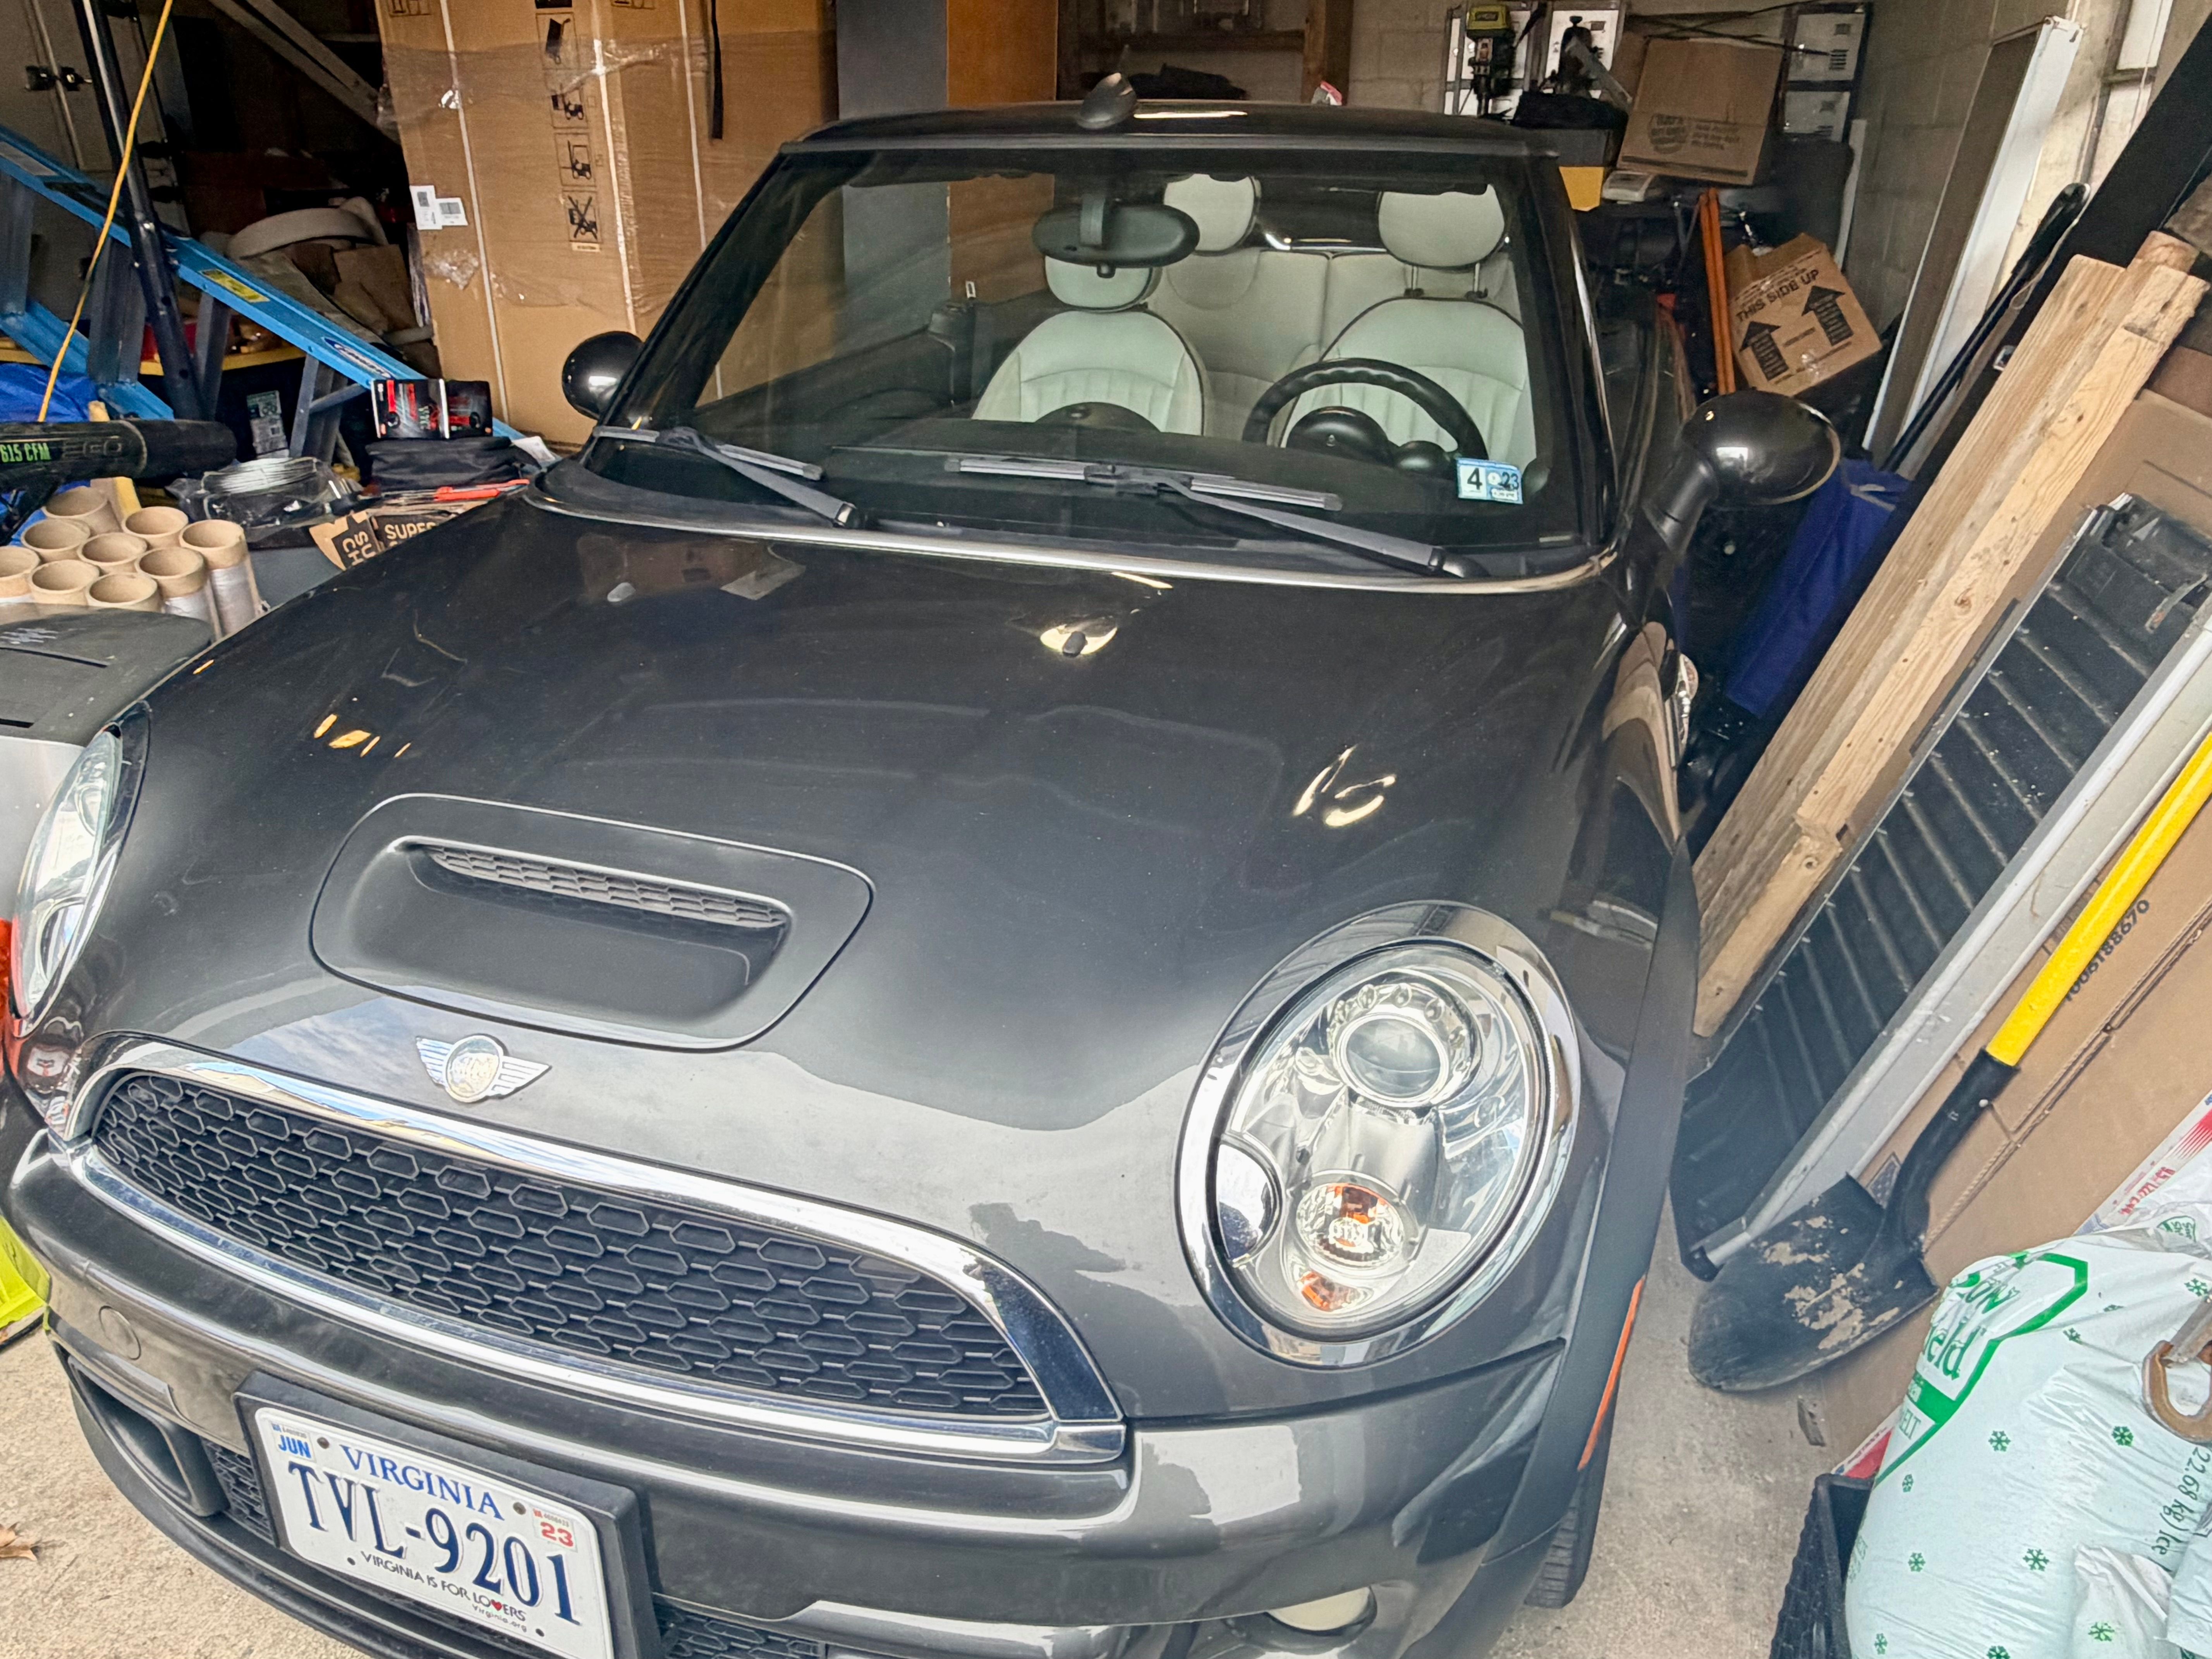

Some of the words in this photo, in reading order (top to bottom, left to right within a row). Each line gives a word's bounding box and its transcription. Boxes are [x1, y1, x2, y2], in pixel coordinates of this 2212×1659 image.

[1736, 298, 1766, 322] THIS
[1767, 280, 1800, 304] SIDE
[1801, 269, 1819, 285] UP
[24, 442, 52, 461] CFM
[1467, 467, 1483, 490] 4
[1498, 471, 1519, 491] 23
[1898, 1408, 1922, 1441] ELT
[278, 1434, 311, 1458] JUN
[340, 1444, 505, 1520] VIRGINIA
[2178, 1446, 2211, 1501] 22.68
[288, 1460, 582, 1626] TVL-9201
[540, 1521, 574, 1547] 23
[2151, 1530, 2183, 1555] Ice
[361, 1551, 425, 1583] VIRGINIA
[426, 1574, 438, 1588] IS
[441, 1580, 471, 1601] FOR
